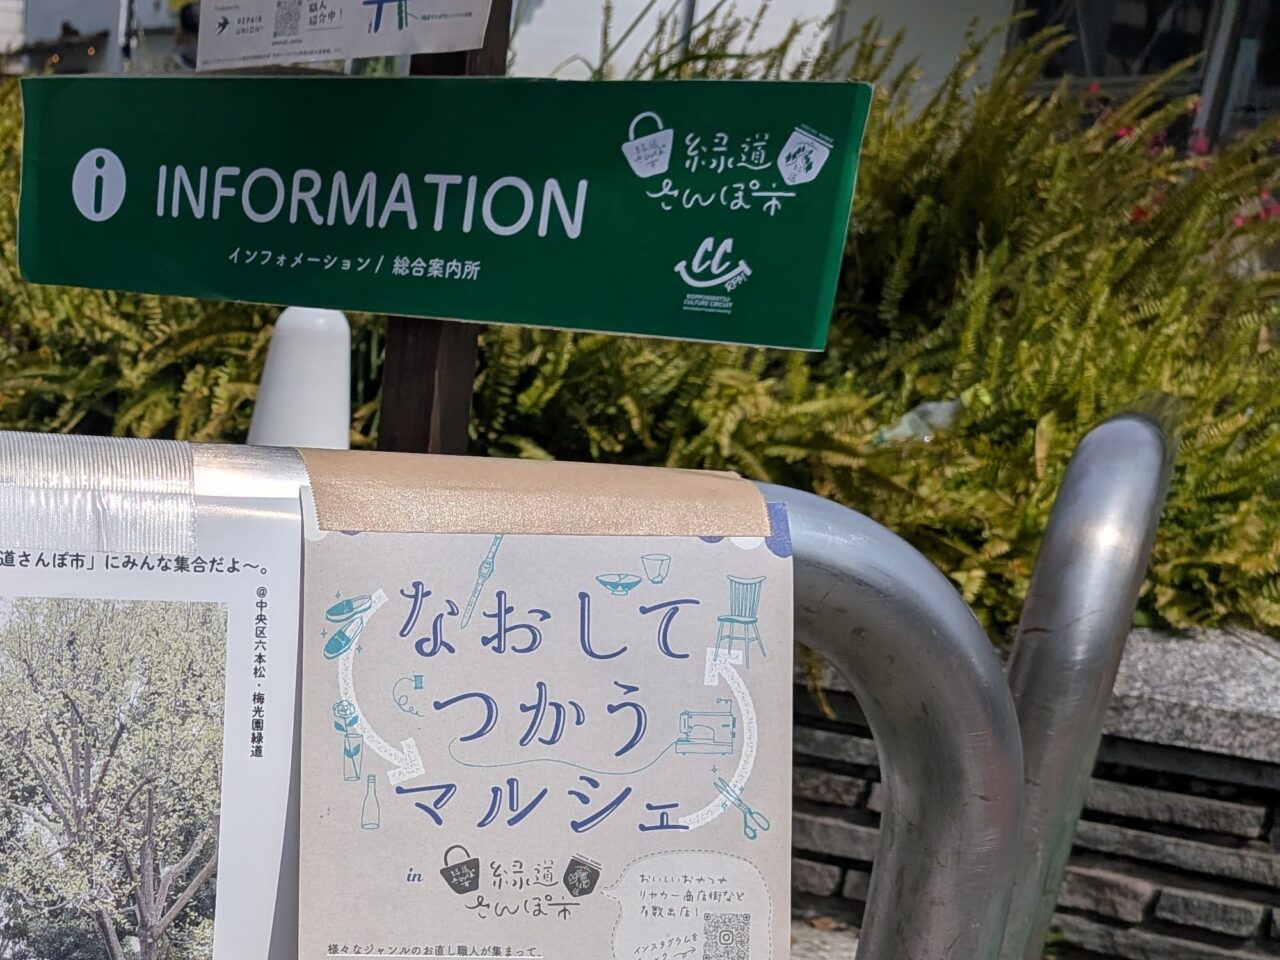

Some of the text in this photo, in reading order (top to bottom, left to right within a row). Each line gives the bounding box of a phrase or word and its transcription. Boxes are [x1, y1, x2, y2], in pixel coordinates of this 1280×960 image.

[237, 15, 263, 25] REPAIR
[156, 165, 588, 239] INFORMATION
[392, 256, 480, 280] 総合案内所
[399, 581, 701, 660] なおして
[433, 680, 648, 757] つかう
[395, 775, 690, 833] マルシェ
[406, 867, 423, 882] in
[327, 943, 544, 958] 様々なジャンルのお直し職人が集まって、
